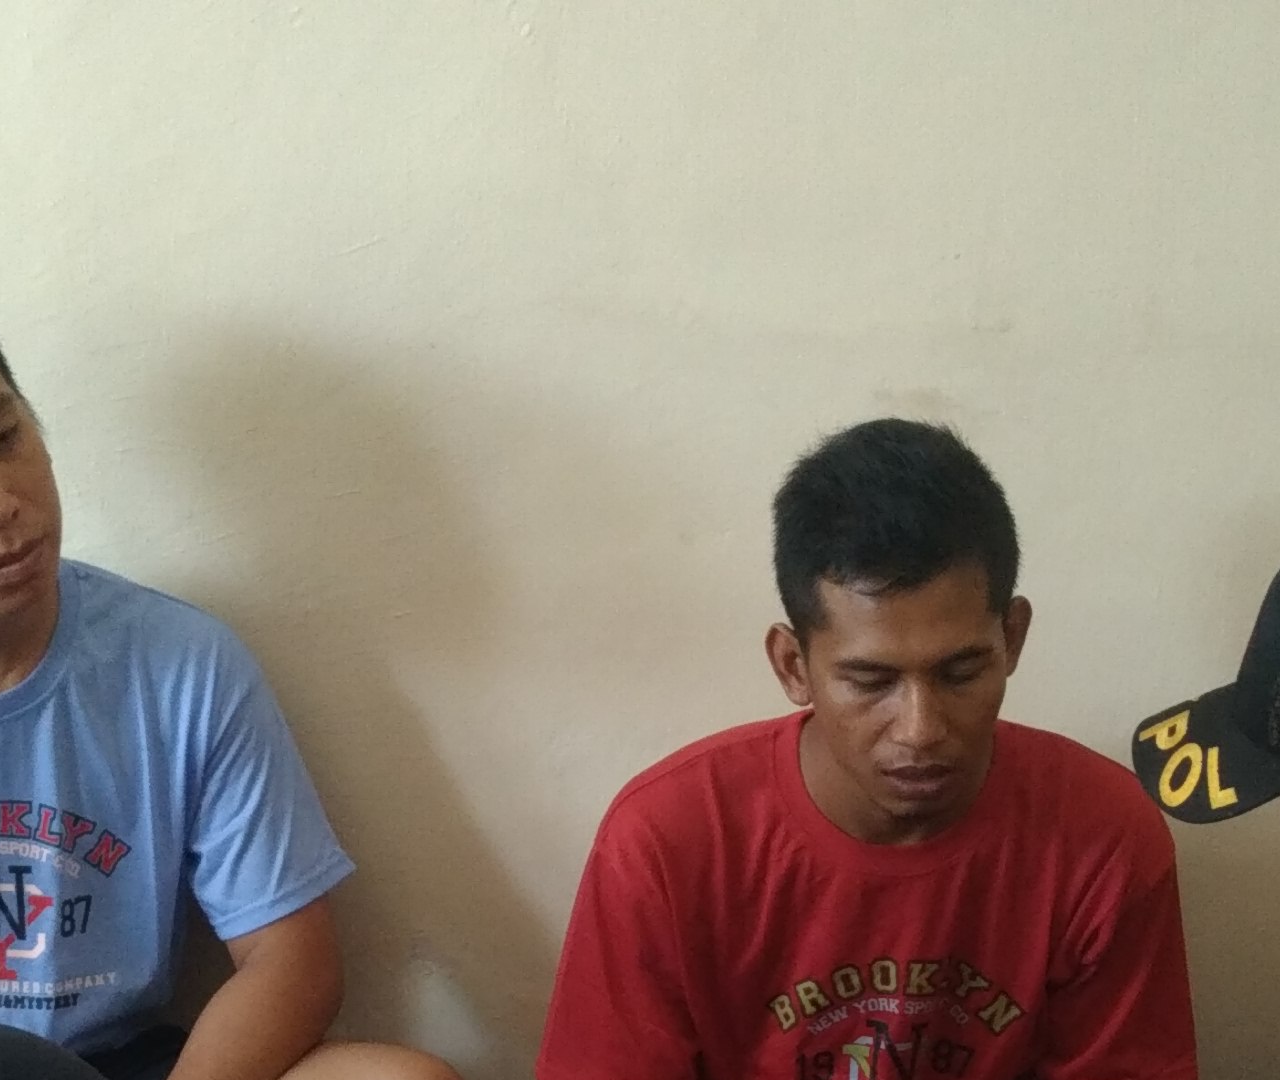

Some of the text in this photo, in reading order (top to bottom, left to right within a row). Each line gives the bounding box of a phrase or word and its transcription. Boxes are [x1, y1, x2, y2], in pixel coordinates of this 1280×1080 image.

[1138, 710, 1238, 809] POL
[60, 895, 93, 938] 87
[767, 955, 1026, 1036] BROOKYN
[807, 1006, 849, 1036] NEW
[852, 998, 900, 1015] YORK
